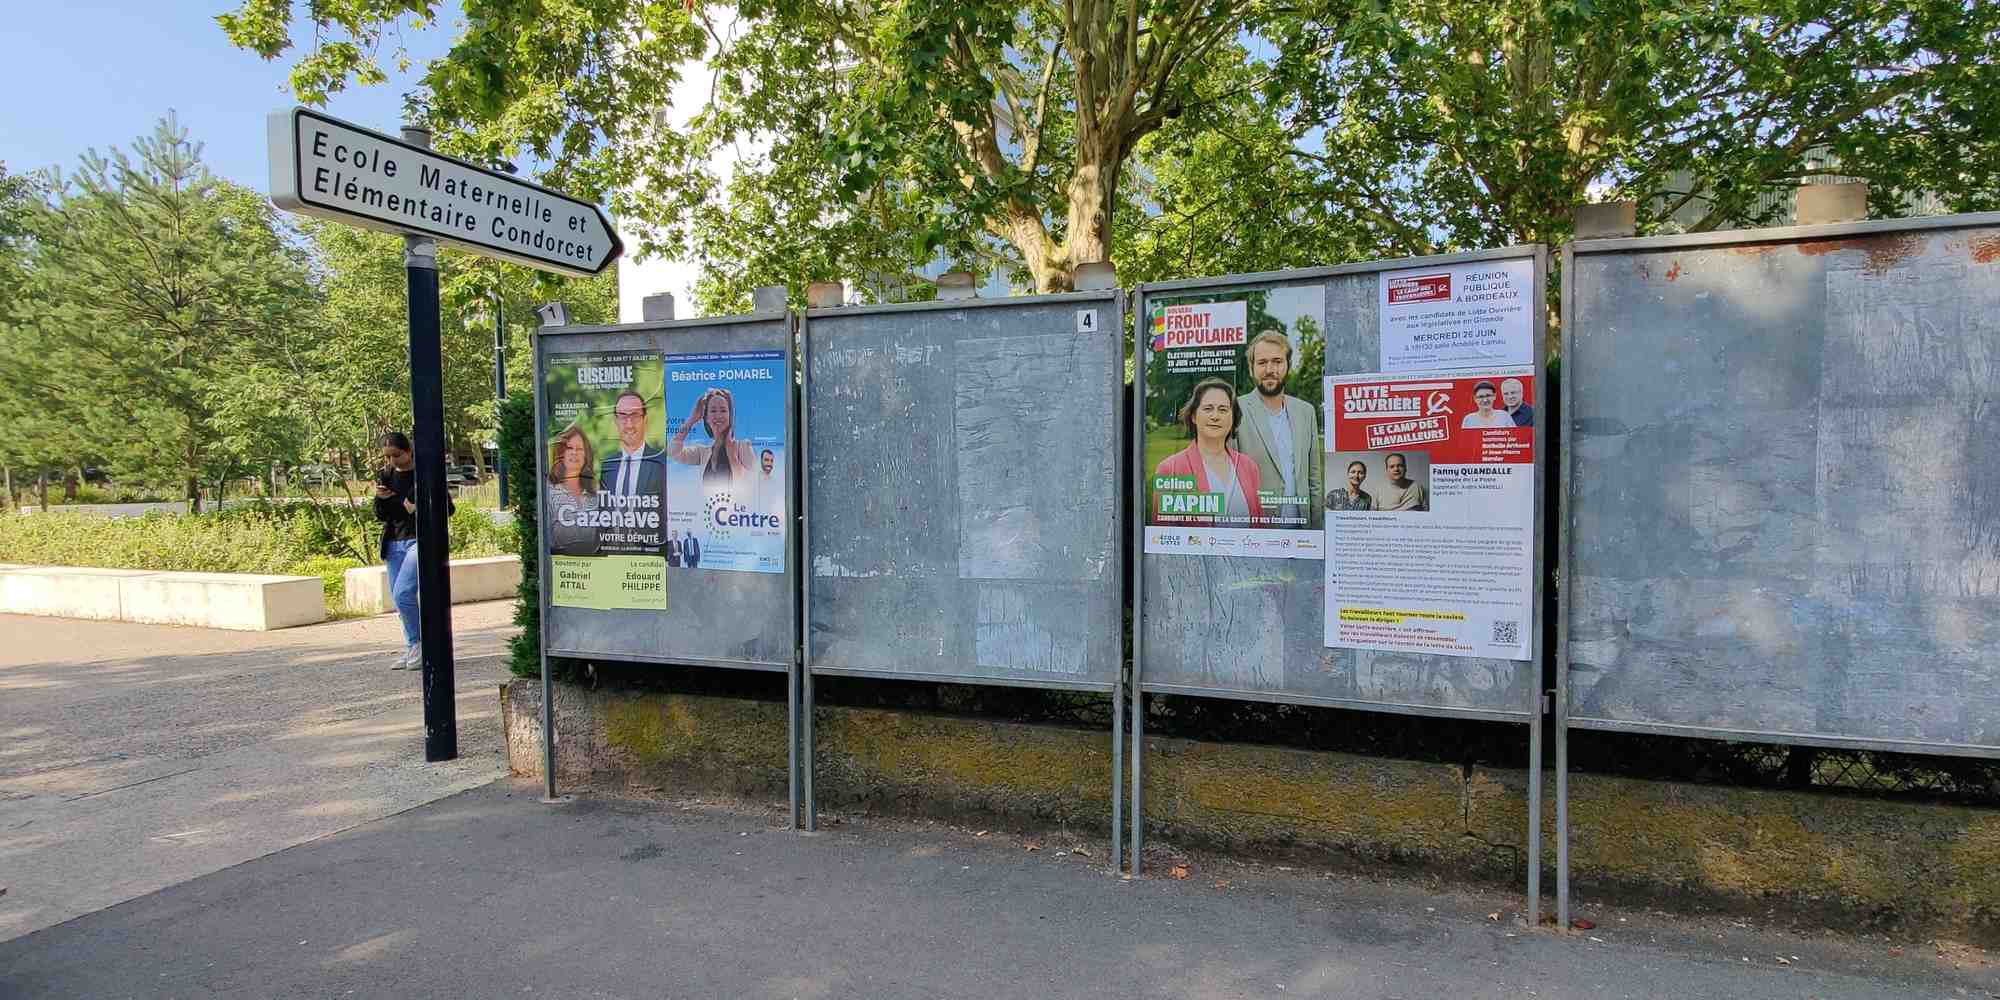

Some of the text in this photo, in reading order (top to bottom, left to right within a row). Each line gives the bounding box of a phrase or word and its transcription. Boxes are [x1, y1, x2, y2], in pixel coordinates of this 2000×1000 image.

[313, 131, 587, 233] Ecole Maternelle et
[315, 167, 593, 262] Elémentaire Condorcet
[1466, 271, 1508, 282] RÉUNION
[1463, 281, 1511, 292] PUBLIQUE
[1465, 291, 1519, 303] BORDEAUX
[548, 306, 556, 319] 1
[1420, 311, 1456, 320] candidats
[1083, 313, 1091, 329] 4
[1167, 313, 1211, 329] FRONT
[1167, 327, 1244, 345] POPULAIRE
[1414, 331, 1460, 342] MERCREDI
[1475, 329, 1497, 338] JUIN
[577, 365, 634, 384] ENSEMBLE
[671, 369, 717, 381] Béatrice
[718, 368, 773, 380] POMAREL
[1344, 384, 1390, 400] LUTTE
[1344, 395, 1421, 412] OUVRIÈRE
[1373, 419, 1439, 436] LE CAMP DES
[1370, 429, 1445, 447] TRAVAILLEURS
[1432, 467, 1513, 476] Fanny QUANDALLE
[1155, 478, 1193, 490] Céline
[596, 490, 660, 508] Thomas
[1162, 494, 1219, 512] PAPIN
[734, 503, 746, 512] Le
[558, 504, 660, 528] Cazenave
[715, 507, 779, 528] Centre
[600, 532, 659, 543] VOTRE DÉPUTÉ
[560, 570, 591, 580] Gabriel
[626, 571, 661, 581] Edouard
[560, 581, 587, 590] ATTAL
[622, 582, 661, 591] PHILIPPE
